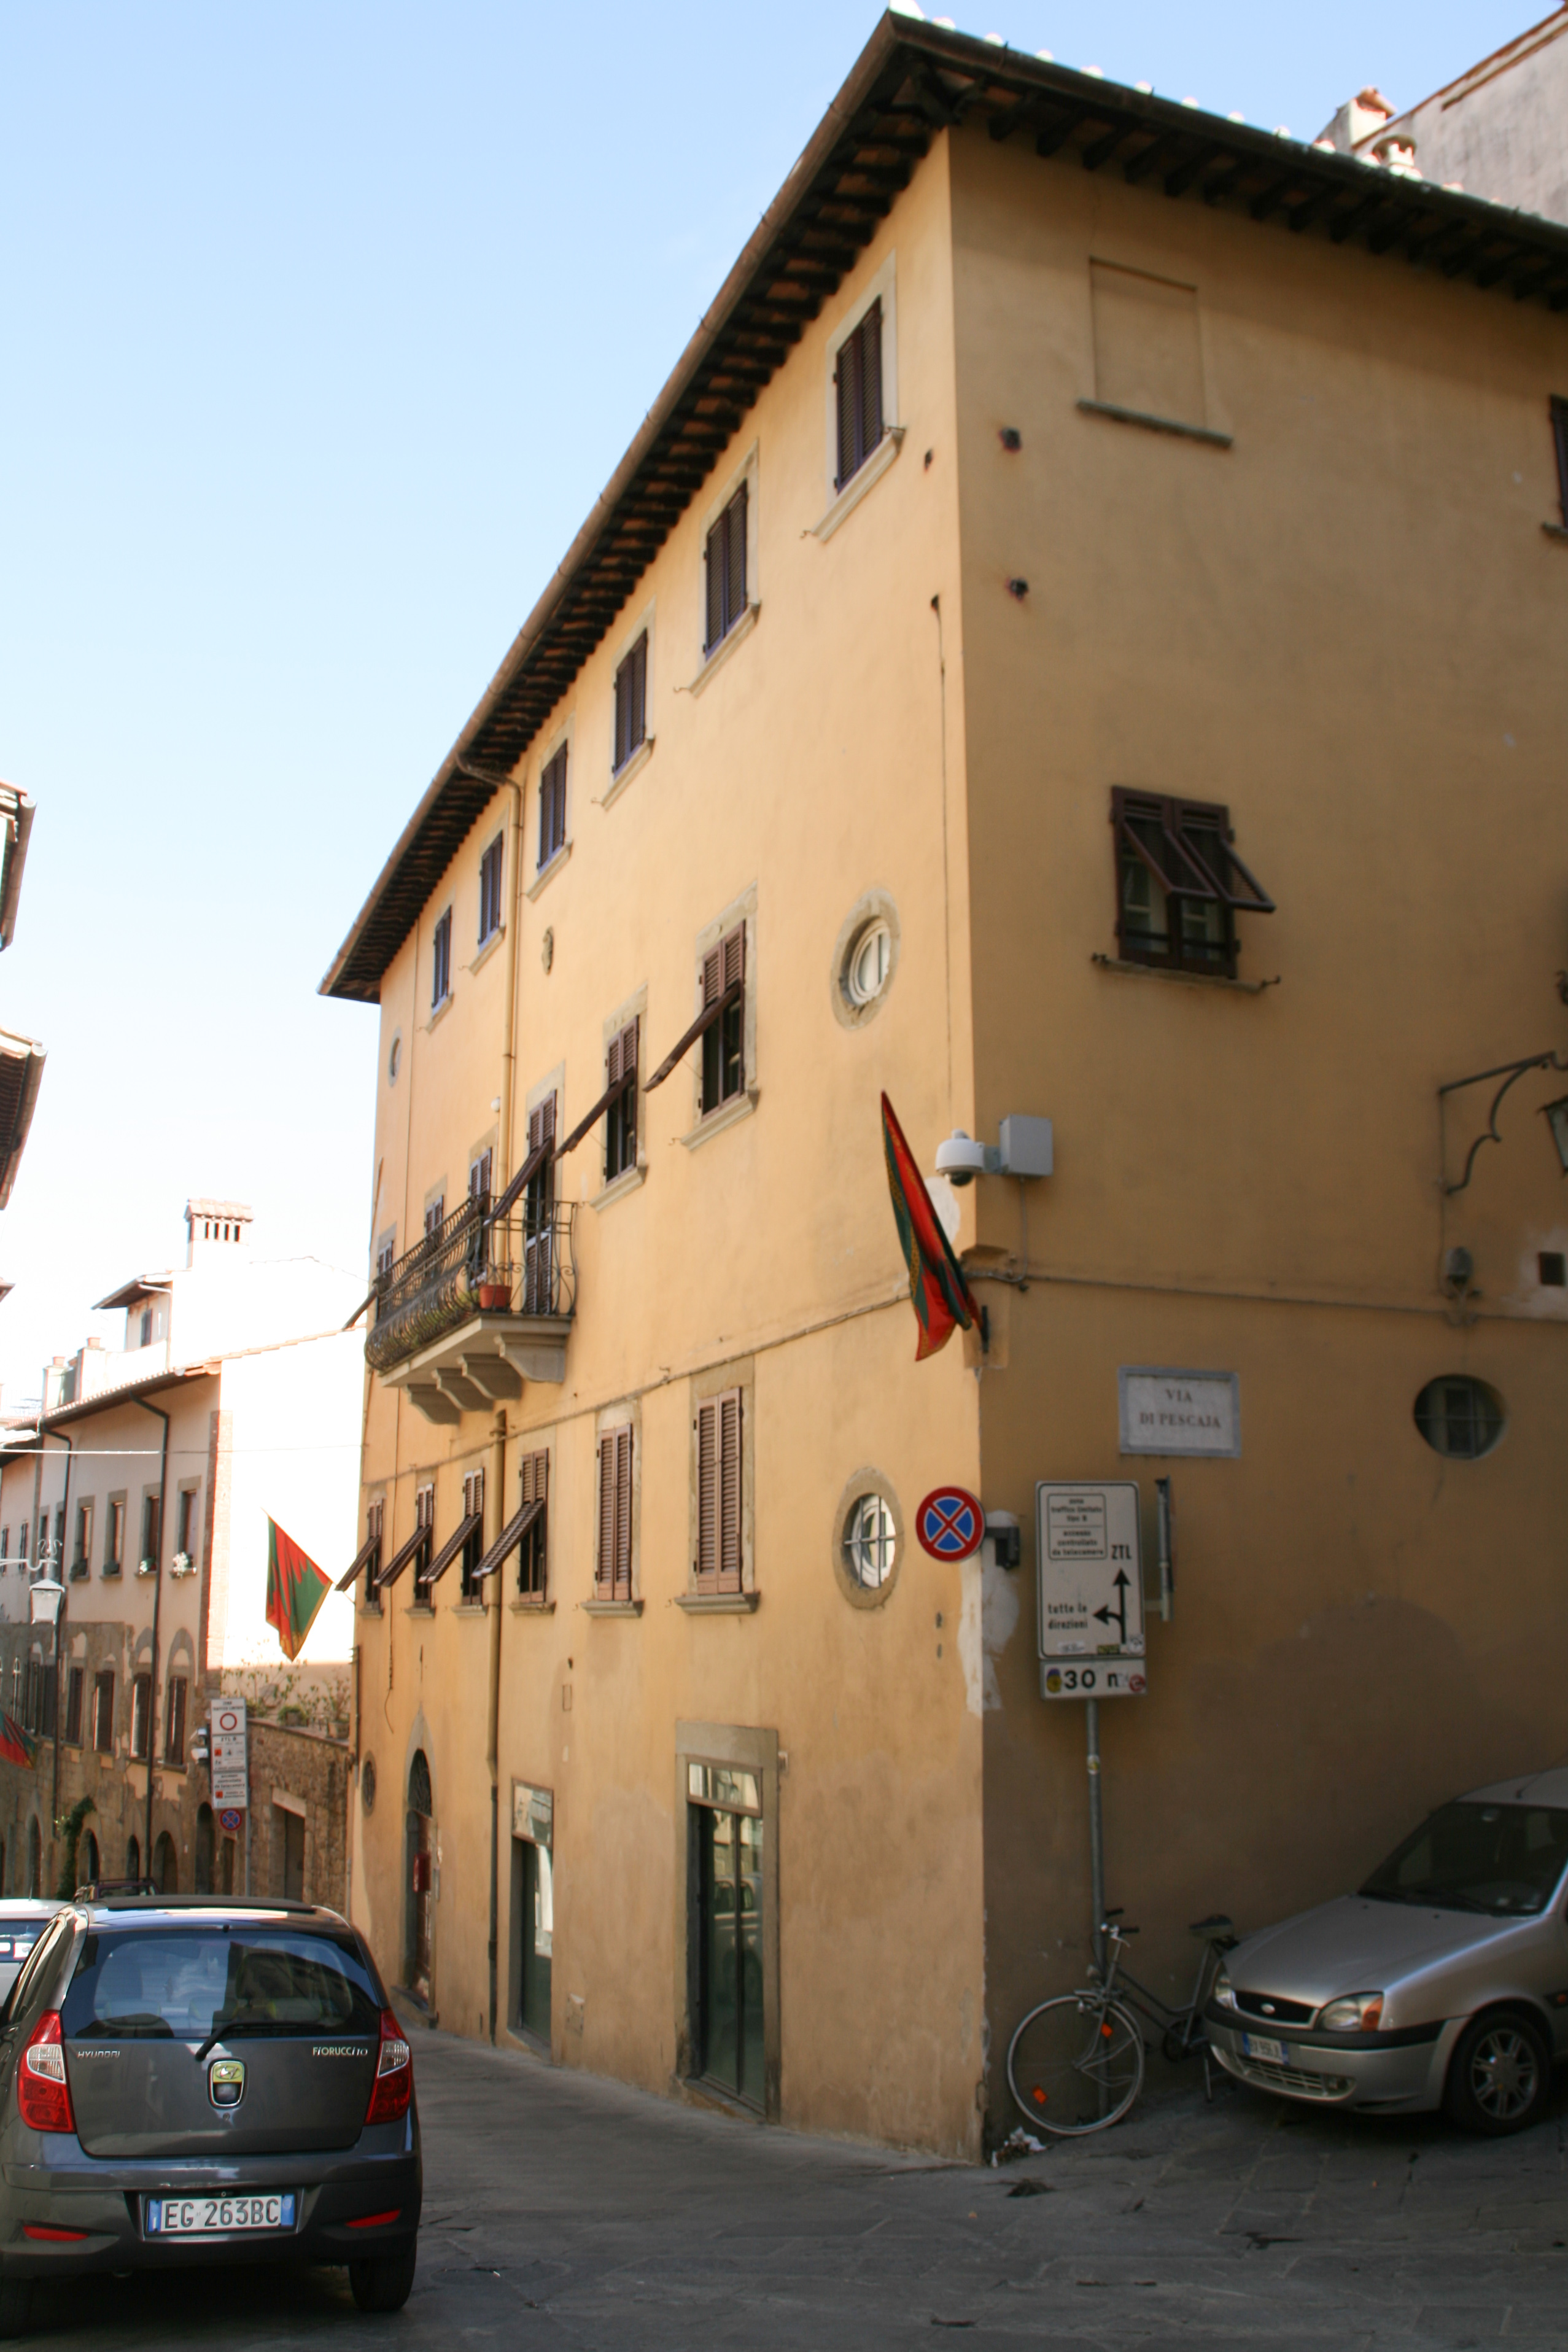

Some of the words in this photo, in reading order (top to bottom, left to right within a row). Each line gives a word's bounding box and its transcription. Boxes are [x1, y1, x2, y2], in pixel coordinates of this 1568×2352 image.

[1165, 1389, 1192, 1402] VIA
[1139, 1412, 1154, 1425] DI
[1159, 1413, 1221, 1428] PESCAIA
[1111, 1544, 1132, 1560] ZTL
[1048, 1603, 1074, 1614] tutte
[1077, 1602, 1087, 1613] le
[1047, 1618, 1089, 1629] direzioni
[1064, 1668, 1096, 1690] 30
[165, 2202, 195, 2229] EG
[204, 2198, 279, 2227] 263BC
